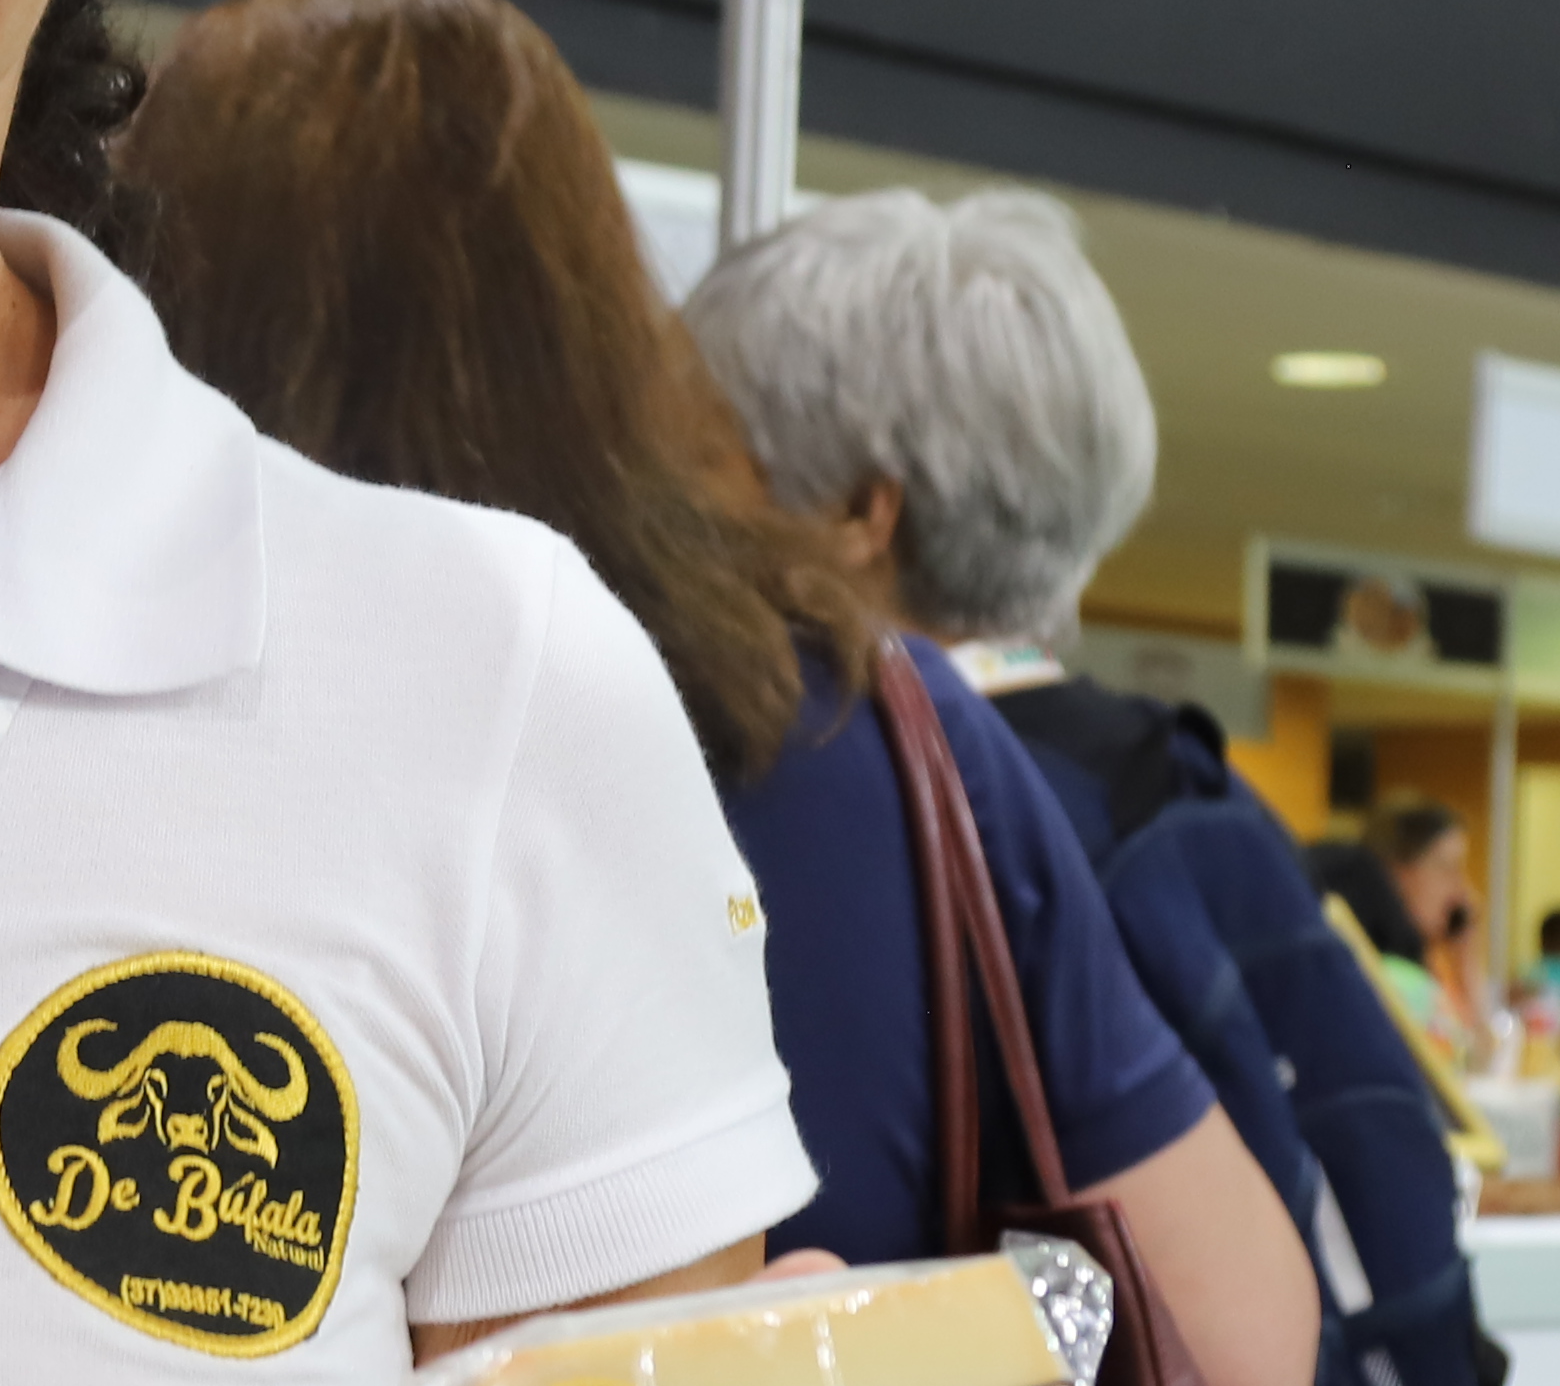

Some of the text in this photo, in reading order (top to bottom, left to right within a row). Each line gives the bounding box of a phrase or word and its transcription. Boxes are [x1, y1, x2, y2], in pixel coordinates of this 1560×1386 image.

[30, 1144, 322, 1243] De Búfala
[252, 1230, 324, 1274] Natural
